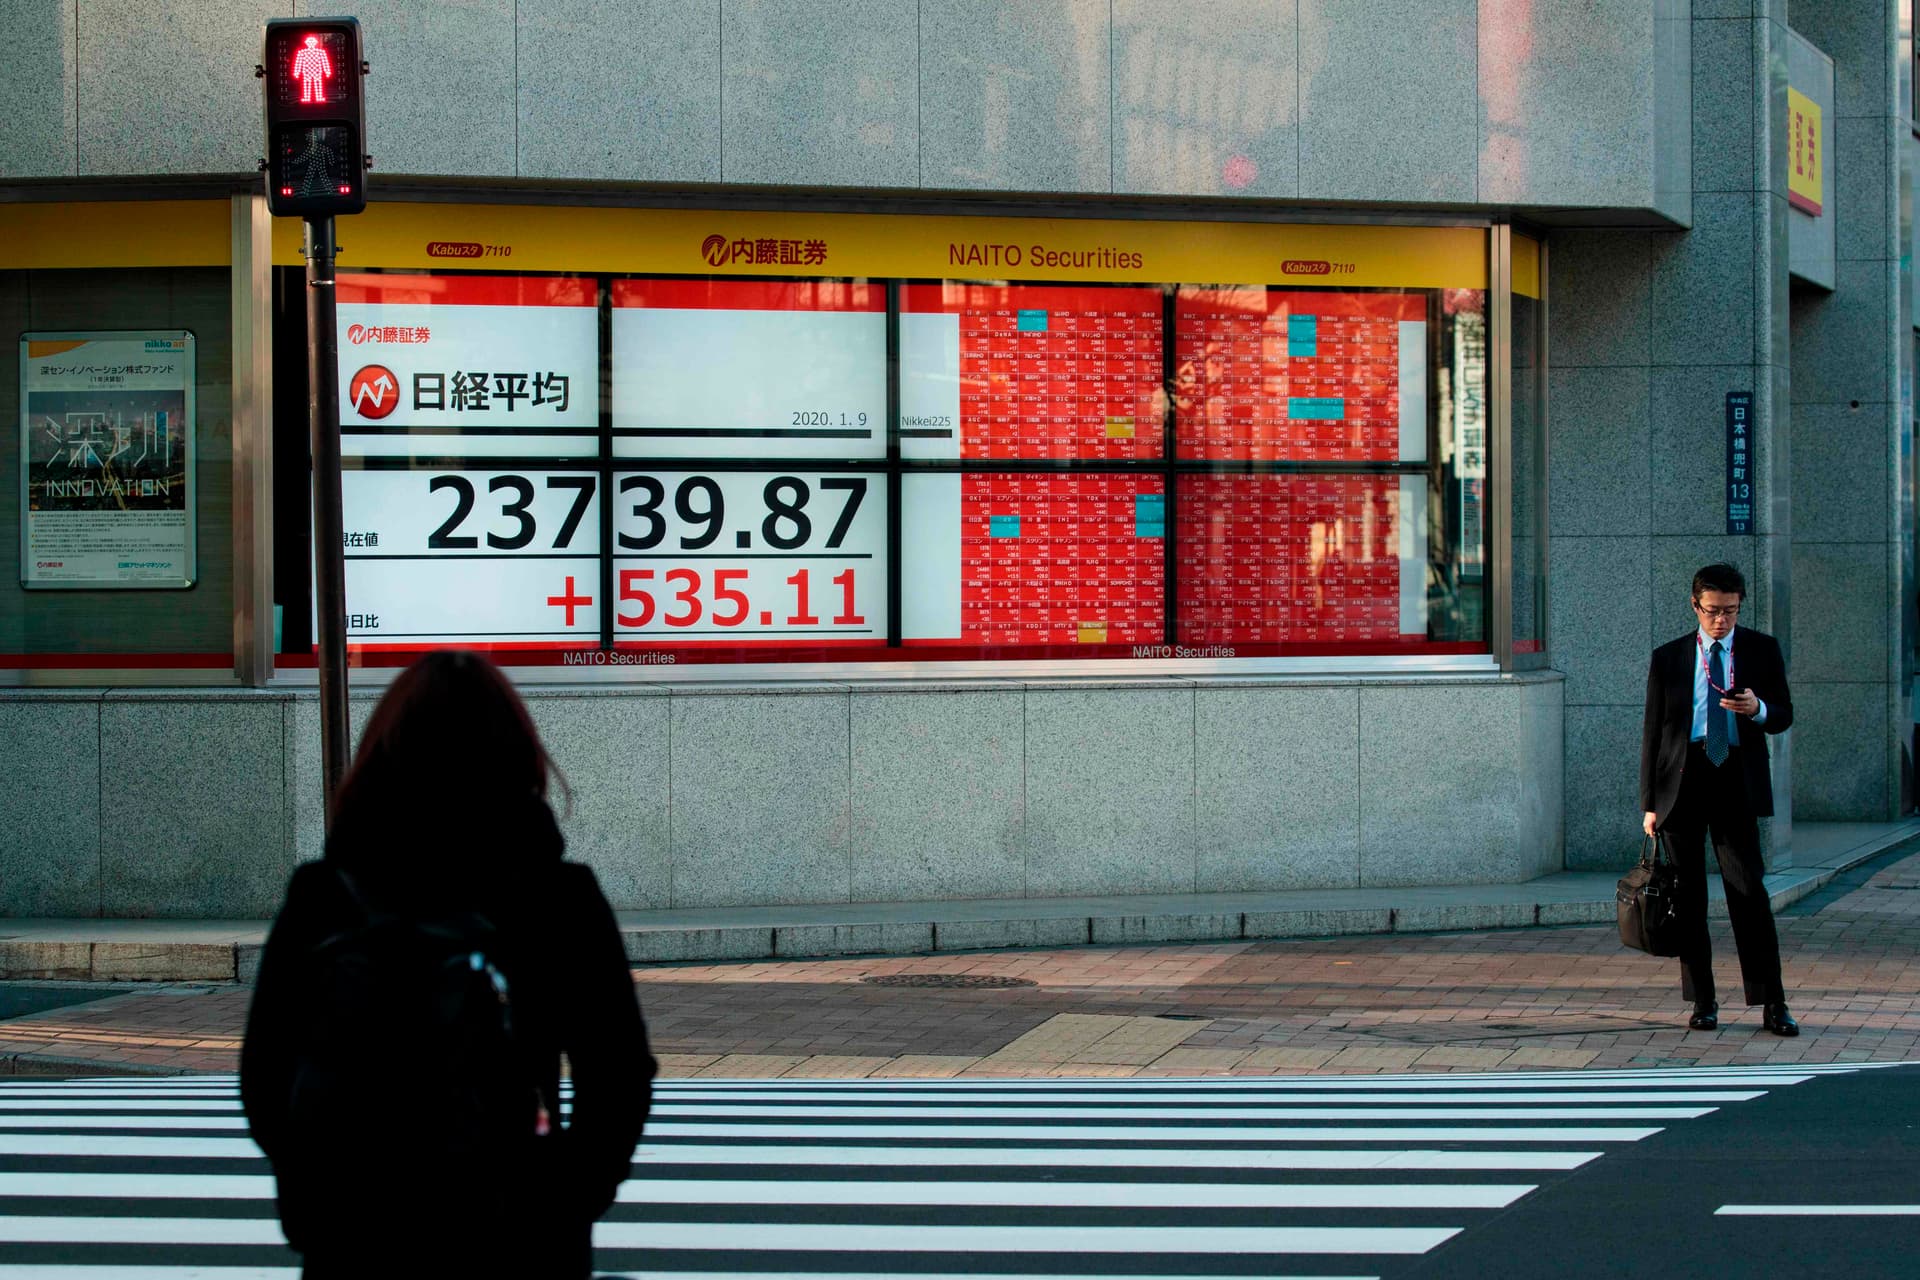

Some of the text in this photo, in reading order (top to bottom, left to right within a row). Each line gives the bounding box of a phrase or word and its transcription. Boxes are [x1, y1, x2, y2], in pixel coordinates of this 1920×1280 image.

[485, 246, 511, 257] 7110
[731, 238, 827, 265] 内藤証券
[950, 243, 1143, 269] NAITO Securities
[1332, 263, 1356, 273] 7110
[367, 326, 430, 344] 内藤証券
[413, 371, 570, 412] 日経平均
[902, 416, 950, 427] Nikkei225
[1733, 407, 1746, 480] 日本橋兜町
[46, 479, 169, 497] INNOVATION
[1730, 484, 1749, 499] 13
[1735, 522, 1745, 531] 13
[346, 614, 379, 629] 日比
[563, 651, 676, 665] NAITO Securities
[1132, 645, 1235, 658] NAITO Securities
